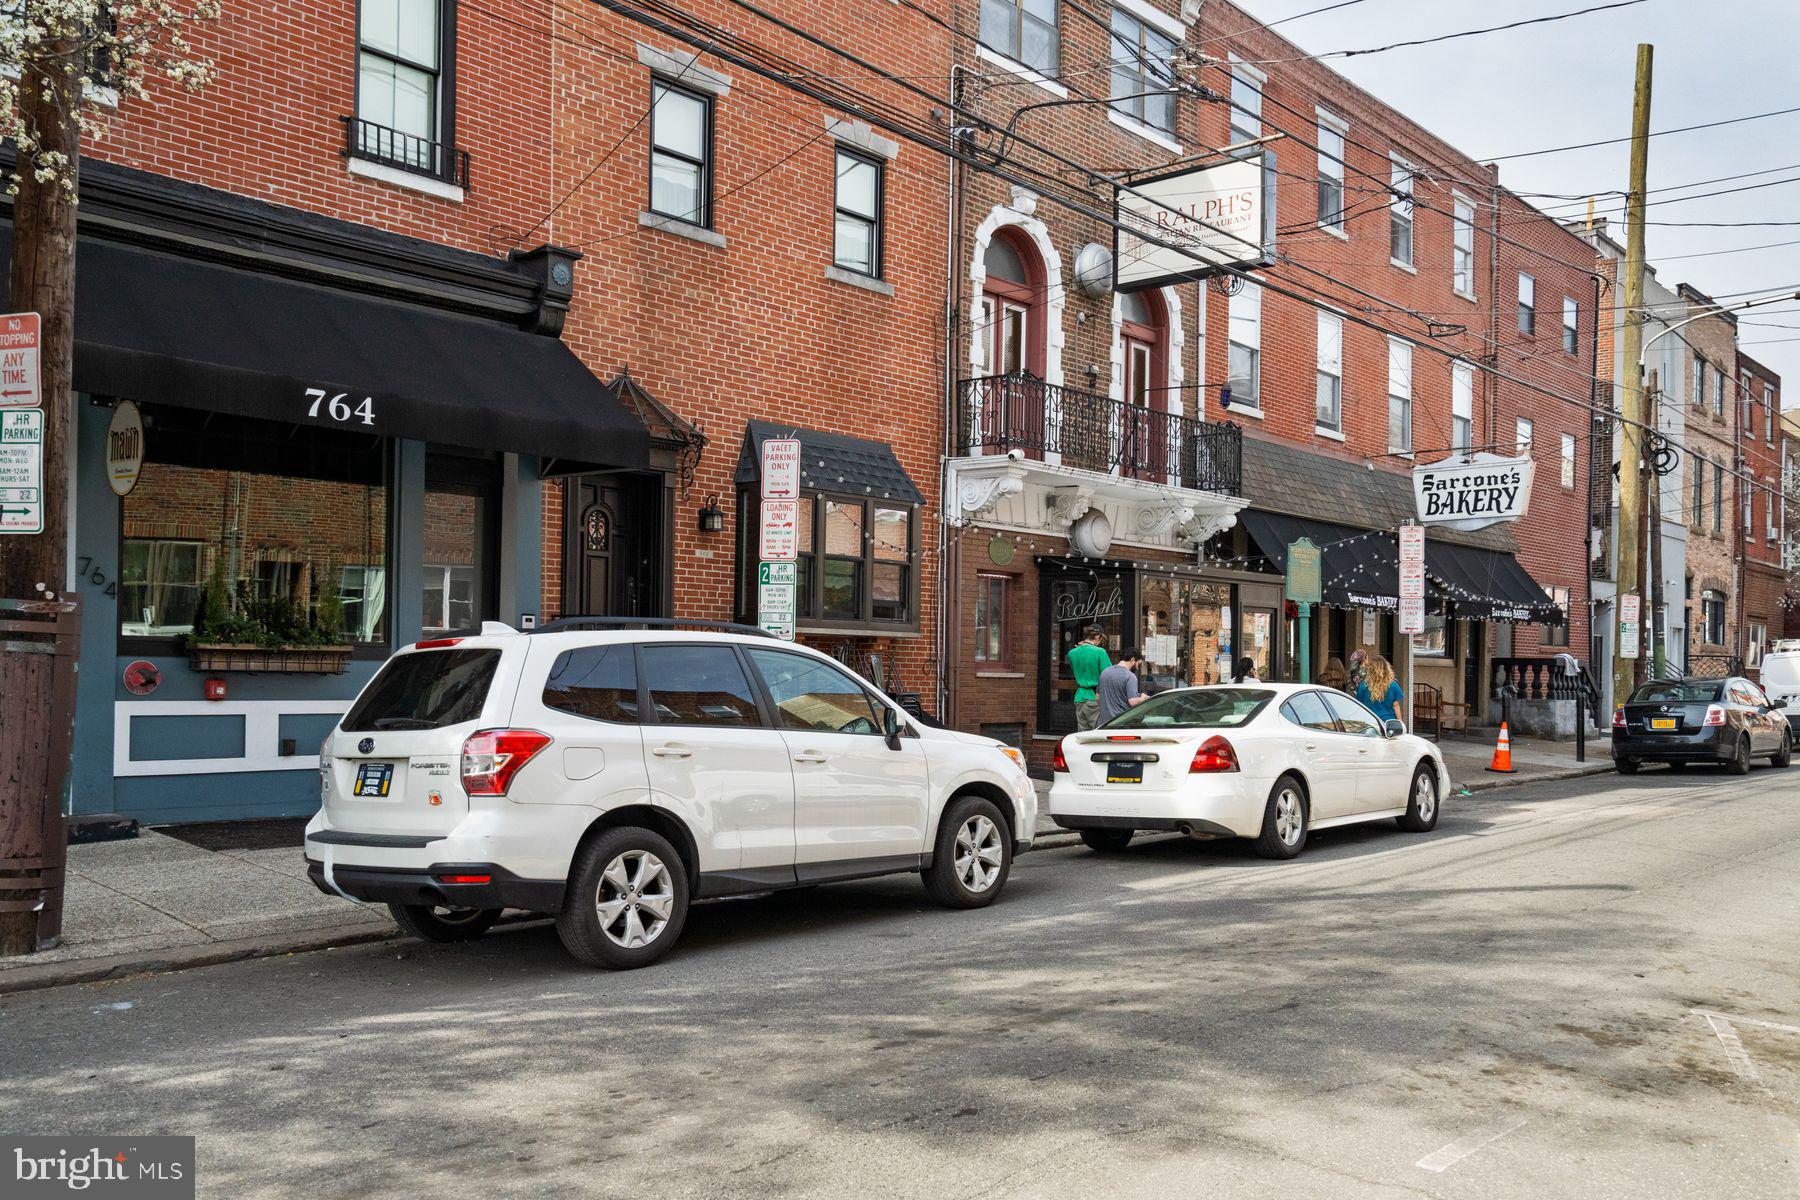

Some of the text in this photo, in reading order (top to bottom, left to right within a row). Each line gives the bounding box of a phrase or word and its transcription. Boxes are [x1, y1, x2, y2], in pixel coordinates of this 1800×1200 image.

[1156, 191, 1253, 230] RALPH'S
[9, 318, 21, 331] NO
[0, 332, 35, 346] TOPPING
[4, 352, 25, 367] ANY
[2, 369, 27, 385] TIME
[304, 387, 376, 426] 764
[4, 427, 39, 440] PARKING
[771, 443, 791, 452] VALET
[765, 453, 797, 461] PARKING
[771, 462, 790, 471] ONLY
[0, 475, 30, 483] HURS-SAT
[1421, 467, 1521, 494] Sarcone's
[19, 490, 31, 500] 22
[1425, 486, 1519, 516] BAKERY
[766, 503, 793, 512] LOADING
[771, 512, 788, 521] ONLY
[78, 556, 118, 600] 764
[761, 566, 769, 583] 2
[770, 573, 794, 582] PARKING
[1347, 592, 1398, 607] Sarcone's BAKERY
